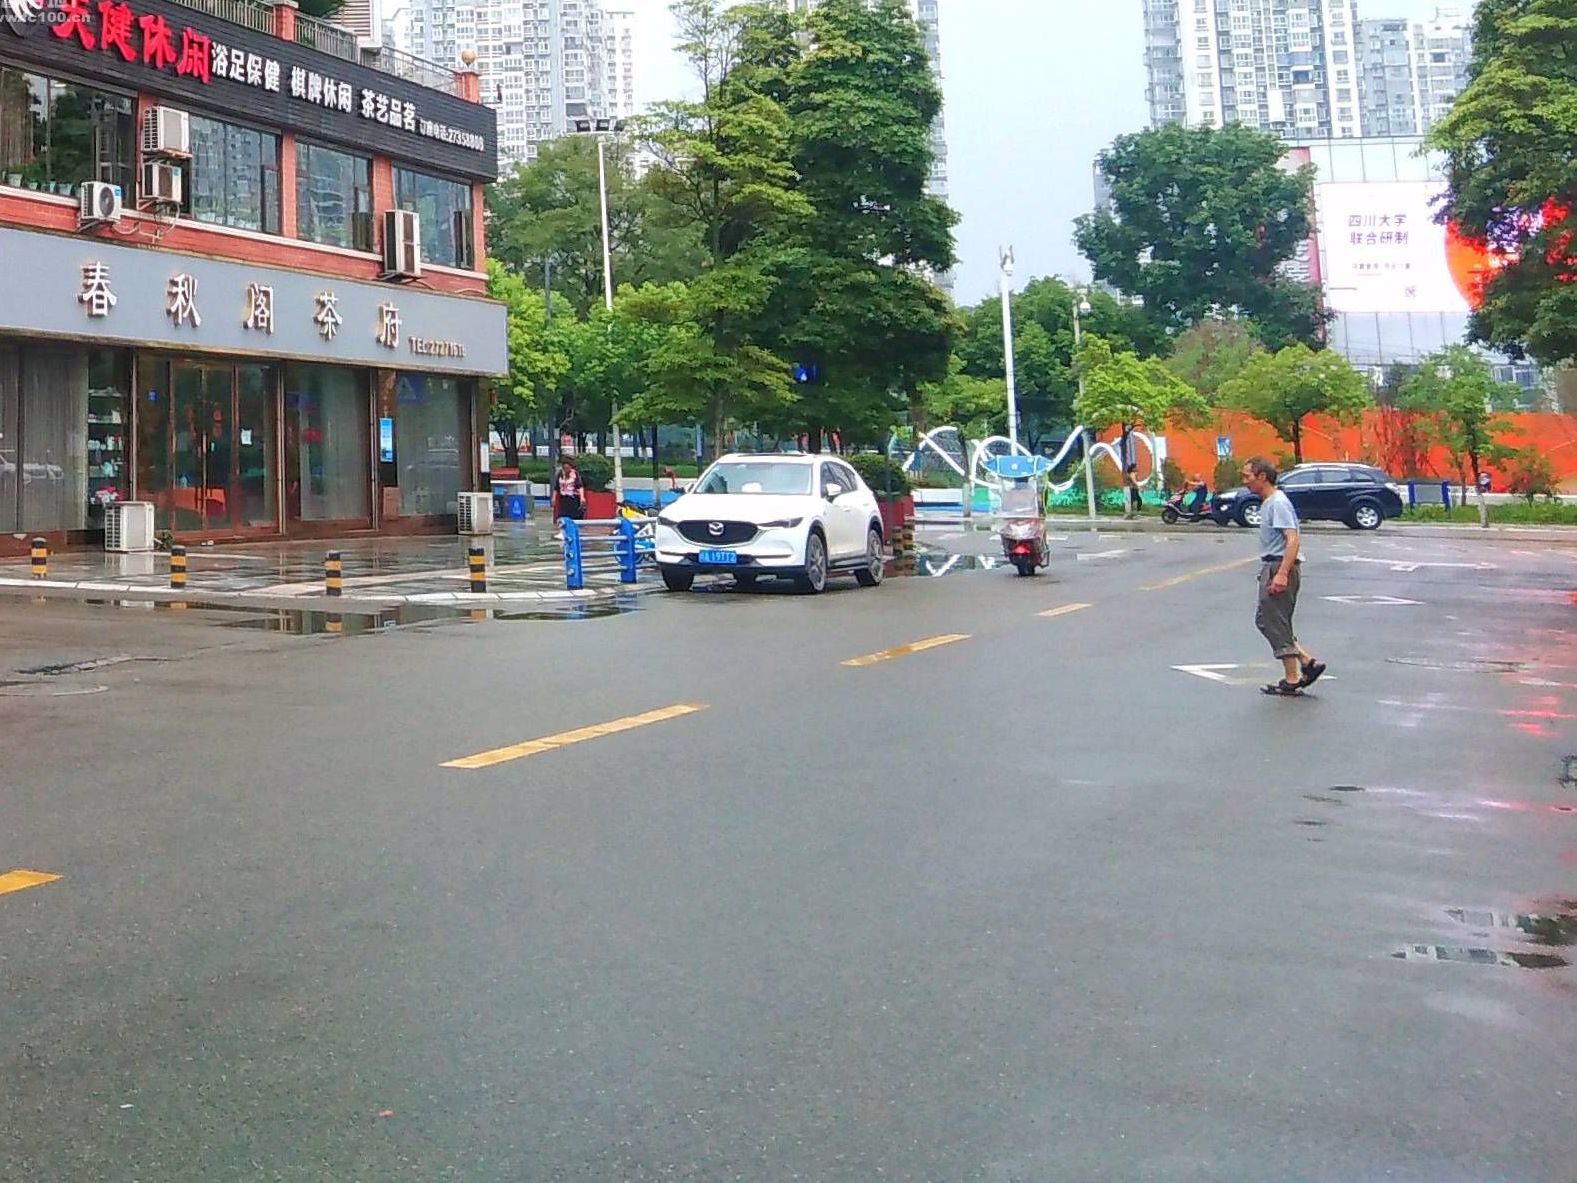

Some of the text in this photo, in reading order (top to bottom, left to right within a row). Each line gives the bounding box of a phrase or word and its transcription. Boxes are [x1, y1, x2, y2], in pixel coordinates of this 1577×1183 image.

[212, 42, 280, 94] 浴足保健
[291, 66, 353, 114] 棋牌休闲
[361, 89, 416, 134] 茶艺品茗
[1348, 214, 1408, 228] 四川大学
[1350, 231, 1410, 245] 联合研制
[79, 261, 403, 349] 春秋阁茶府
